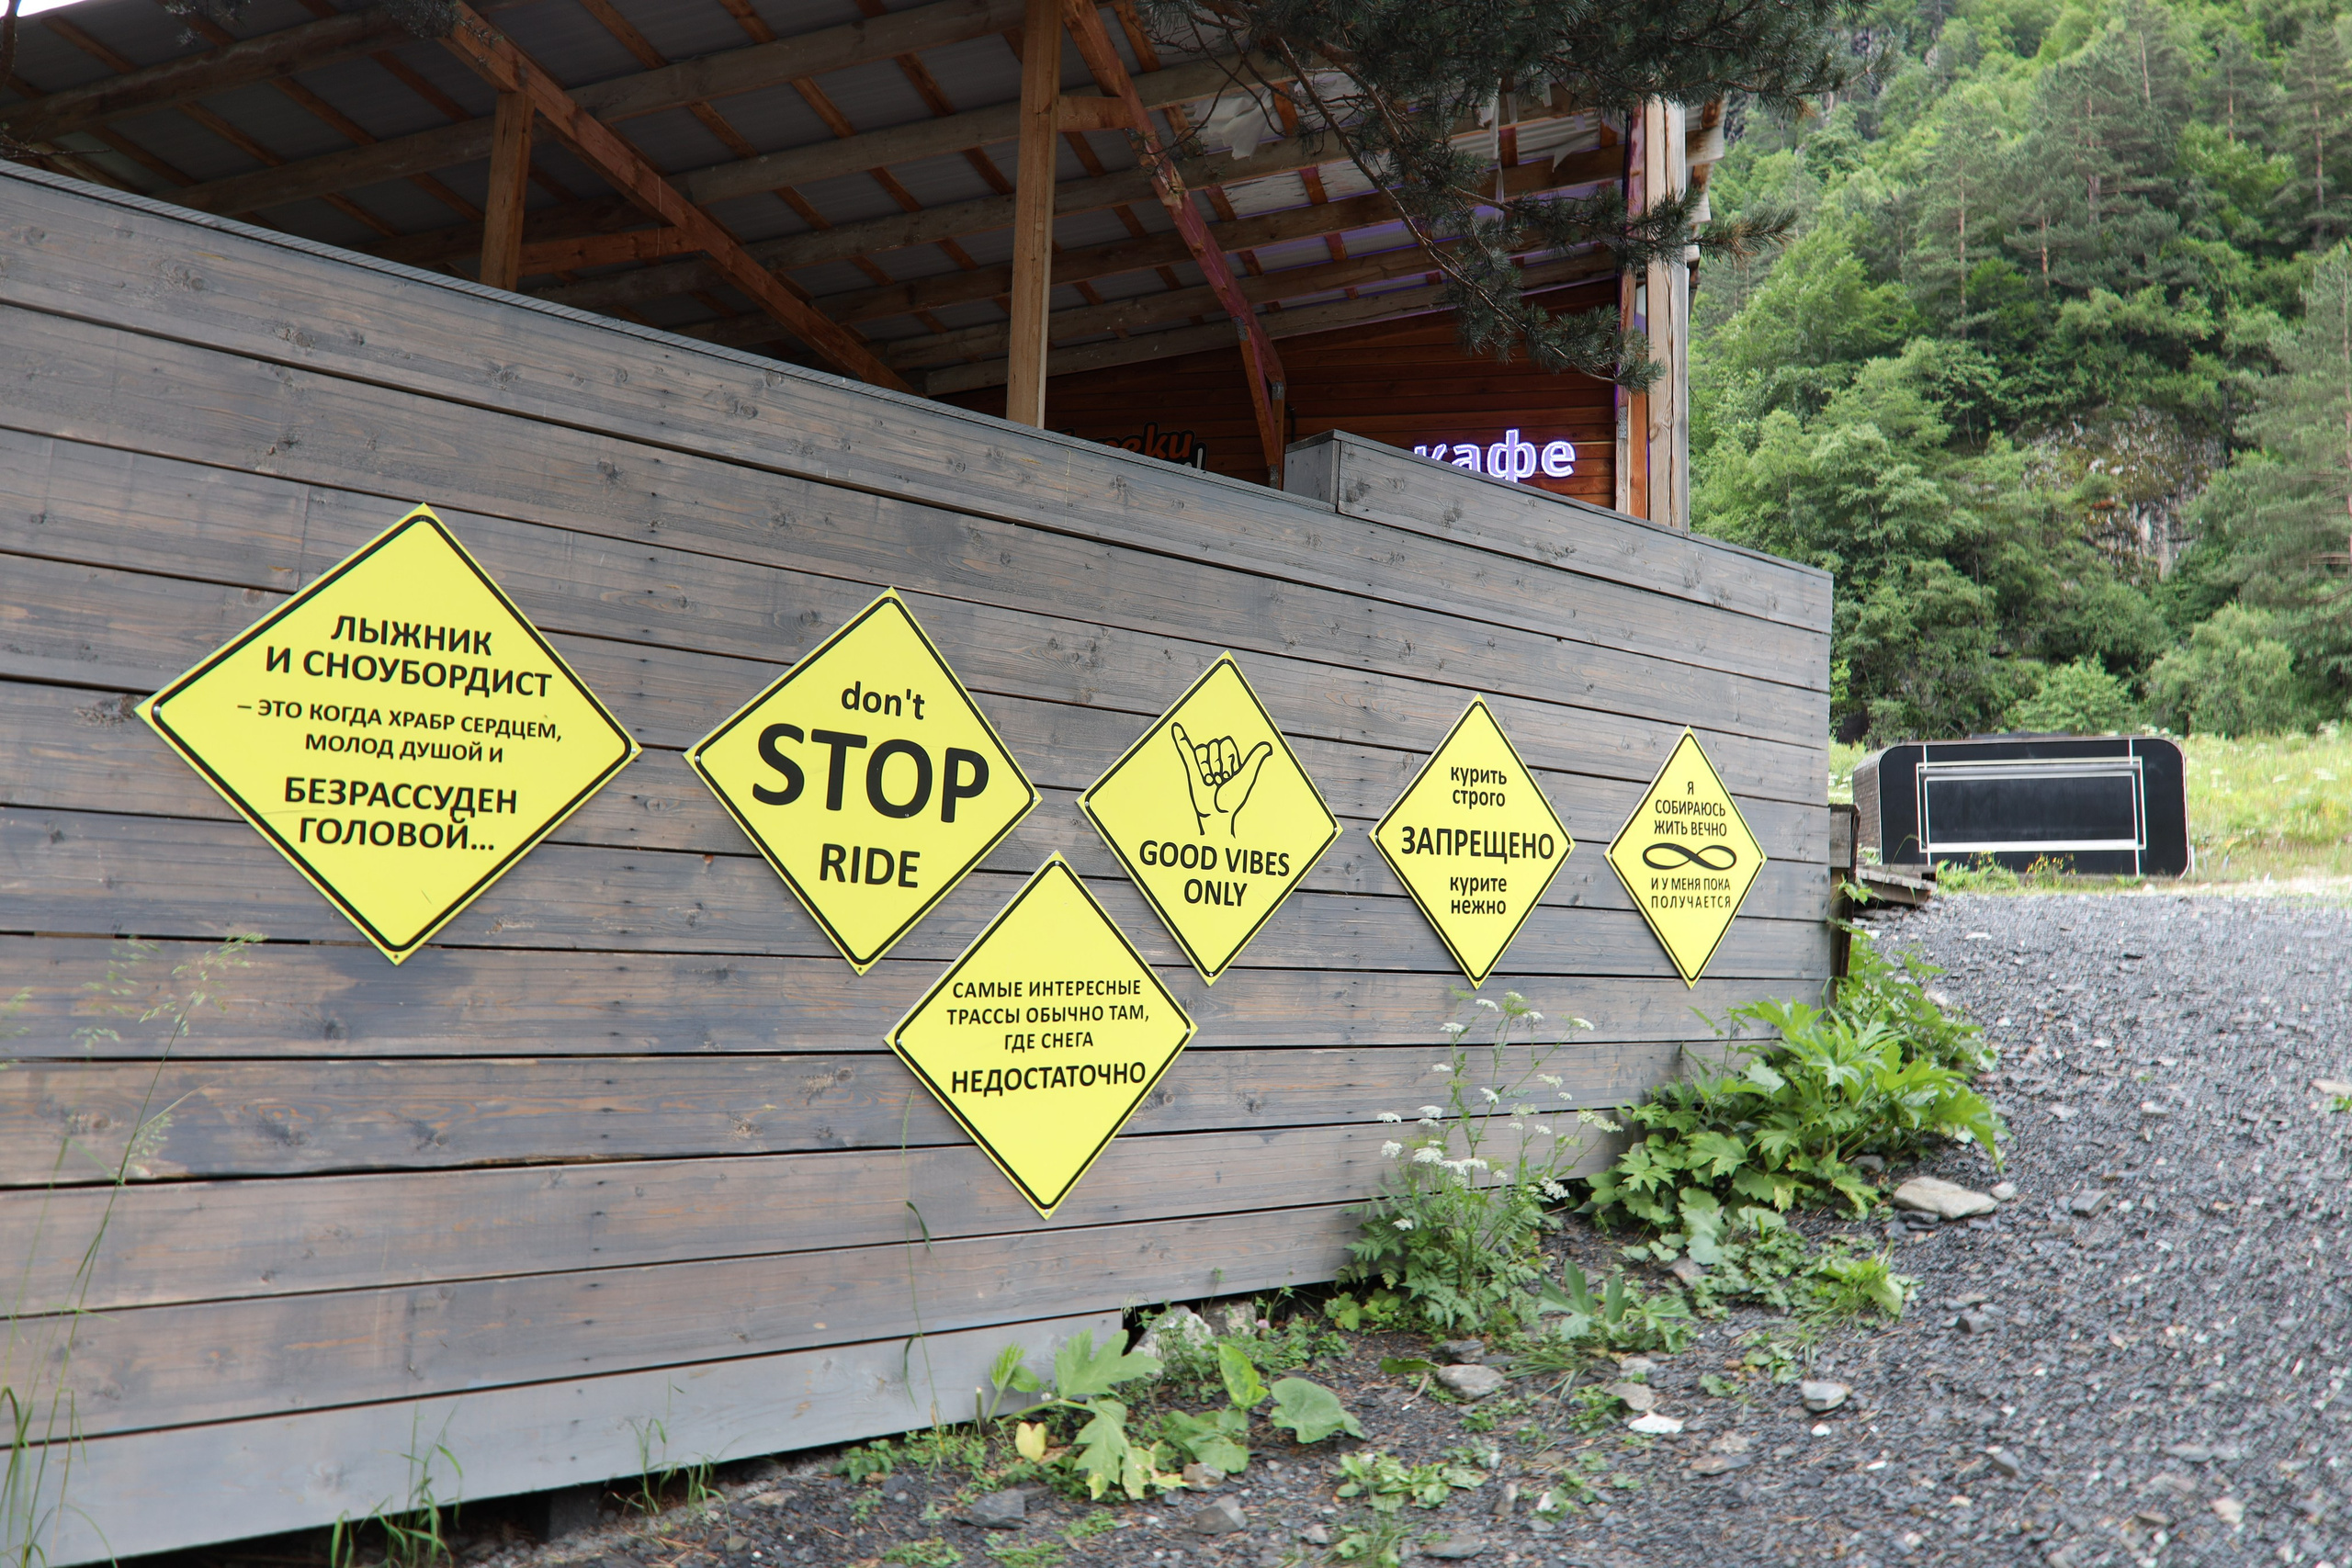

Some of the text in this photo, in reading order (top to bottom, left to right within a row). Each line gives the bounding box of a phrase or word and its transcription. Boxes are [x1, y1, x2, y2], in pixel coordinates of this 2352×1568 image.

[331, 615, 492, 656] ЛЫЖНИК
[266, 646, 552, 697] И СНОУБОРДИСТ
[842, 681, 924, 720] don't
[258, 700, 302, 718] ЭТО
[310, 704, 382, 728] КОГДА
[389, 710, 455, 730] ХРАБР
[460, 716, 562, 742] СЕРДЦЕМ,
[305, 734, 503, 762] МОЛОД ДУШОЙ И
[752, 723, 989, 823] STOP
[1451, 767, 1507, 787] курить
[285, 777, 516, 818] БЕЗРАССУДЕН
[1453, 789, 1505, 809] строго
[1687, 782, 1694, 795] Я
[1656, 799, 1725, 817] СОБИРАЮСЬ
[300, 816, 494, 851] ГОЛОВОЙ...
[1655, 820, 1727, 836] ЖИТЬ ВЕЧНО
[1140, 840, 1289, 876] GOOD VIBES
[1402, 826, 1555, 864] ЗАПРЕЩЕНО
[820, 843, 920, 887] RIDE
[1184, 879, 1248, 907] ONLY
[1450, 876, 1507, 896] курите
[1651, 878, 1731, 890] И У МЕНЯ ПОКА
[1451, 899, 1506, 914] нежно
[1651, 896, 1731, 908] ПОЛУЧАЕТСЯ
[953, 980, 1141, 998] САМЫЕ ИНТЕРЕСНЫЕ
[947, 1005, 1149, 1025] ТРАССЫ ОБЫЧНО ТАМ,
[1004, 1032, 1093, 1053] ГДЕ СНЕГА
[952, 1062, 1146, 1097] НЕДОСТАТОЧНО
